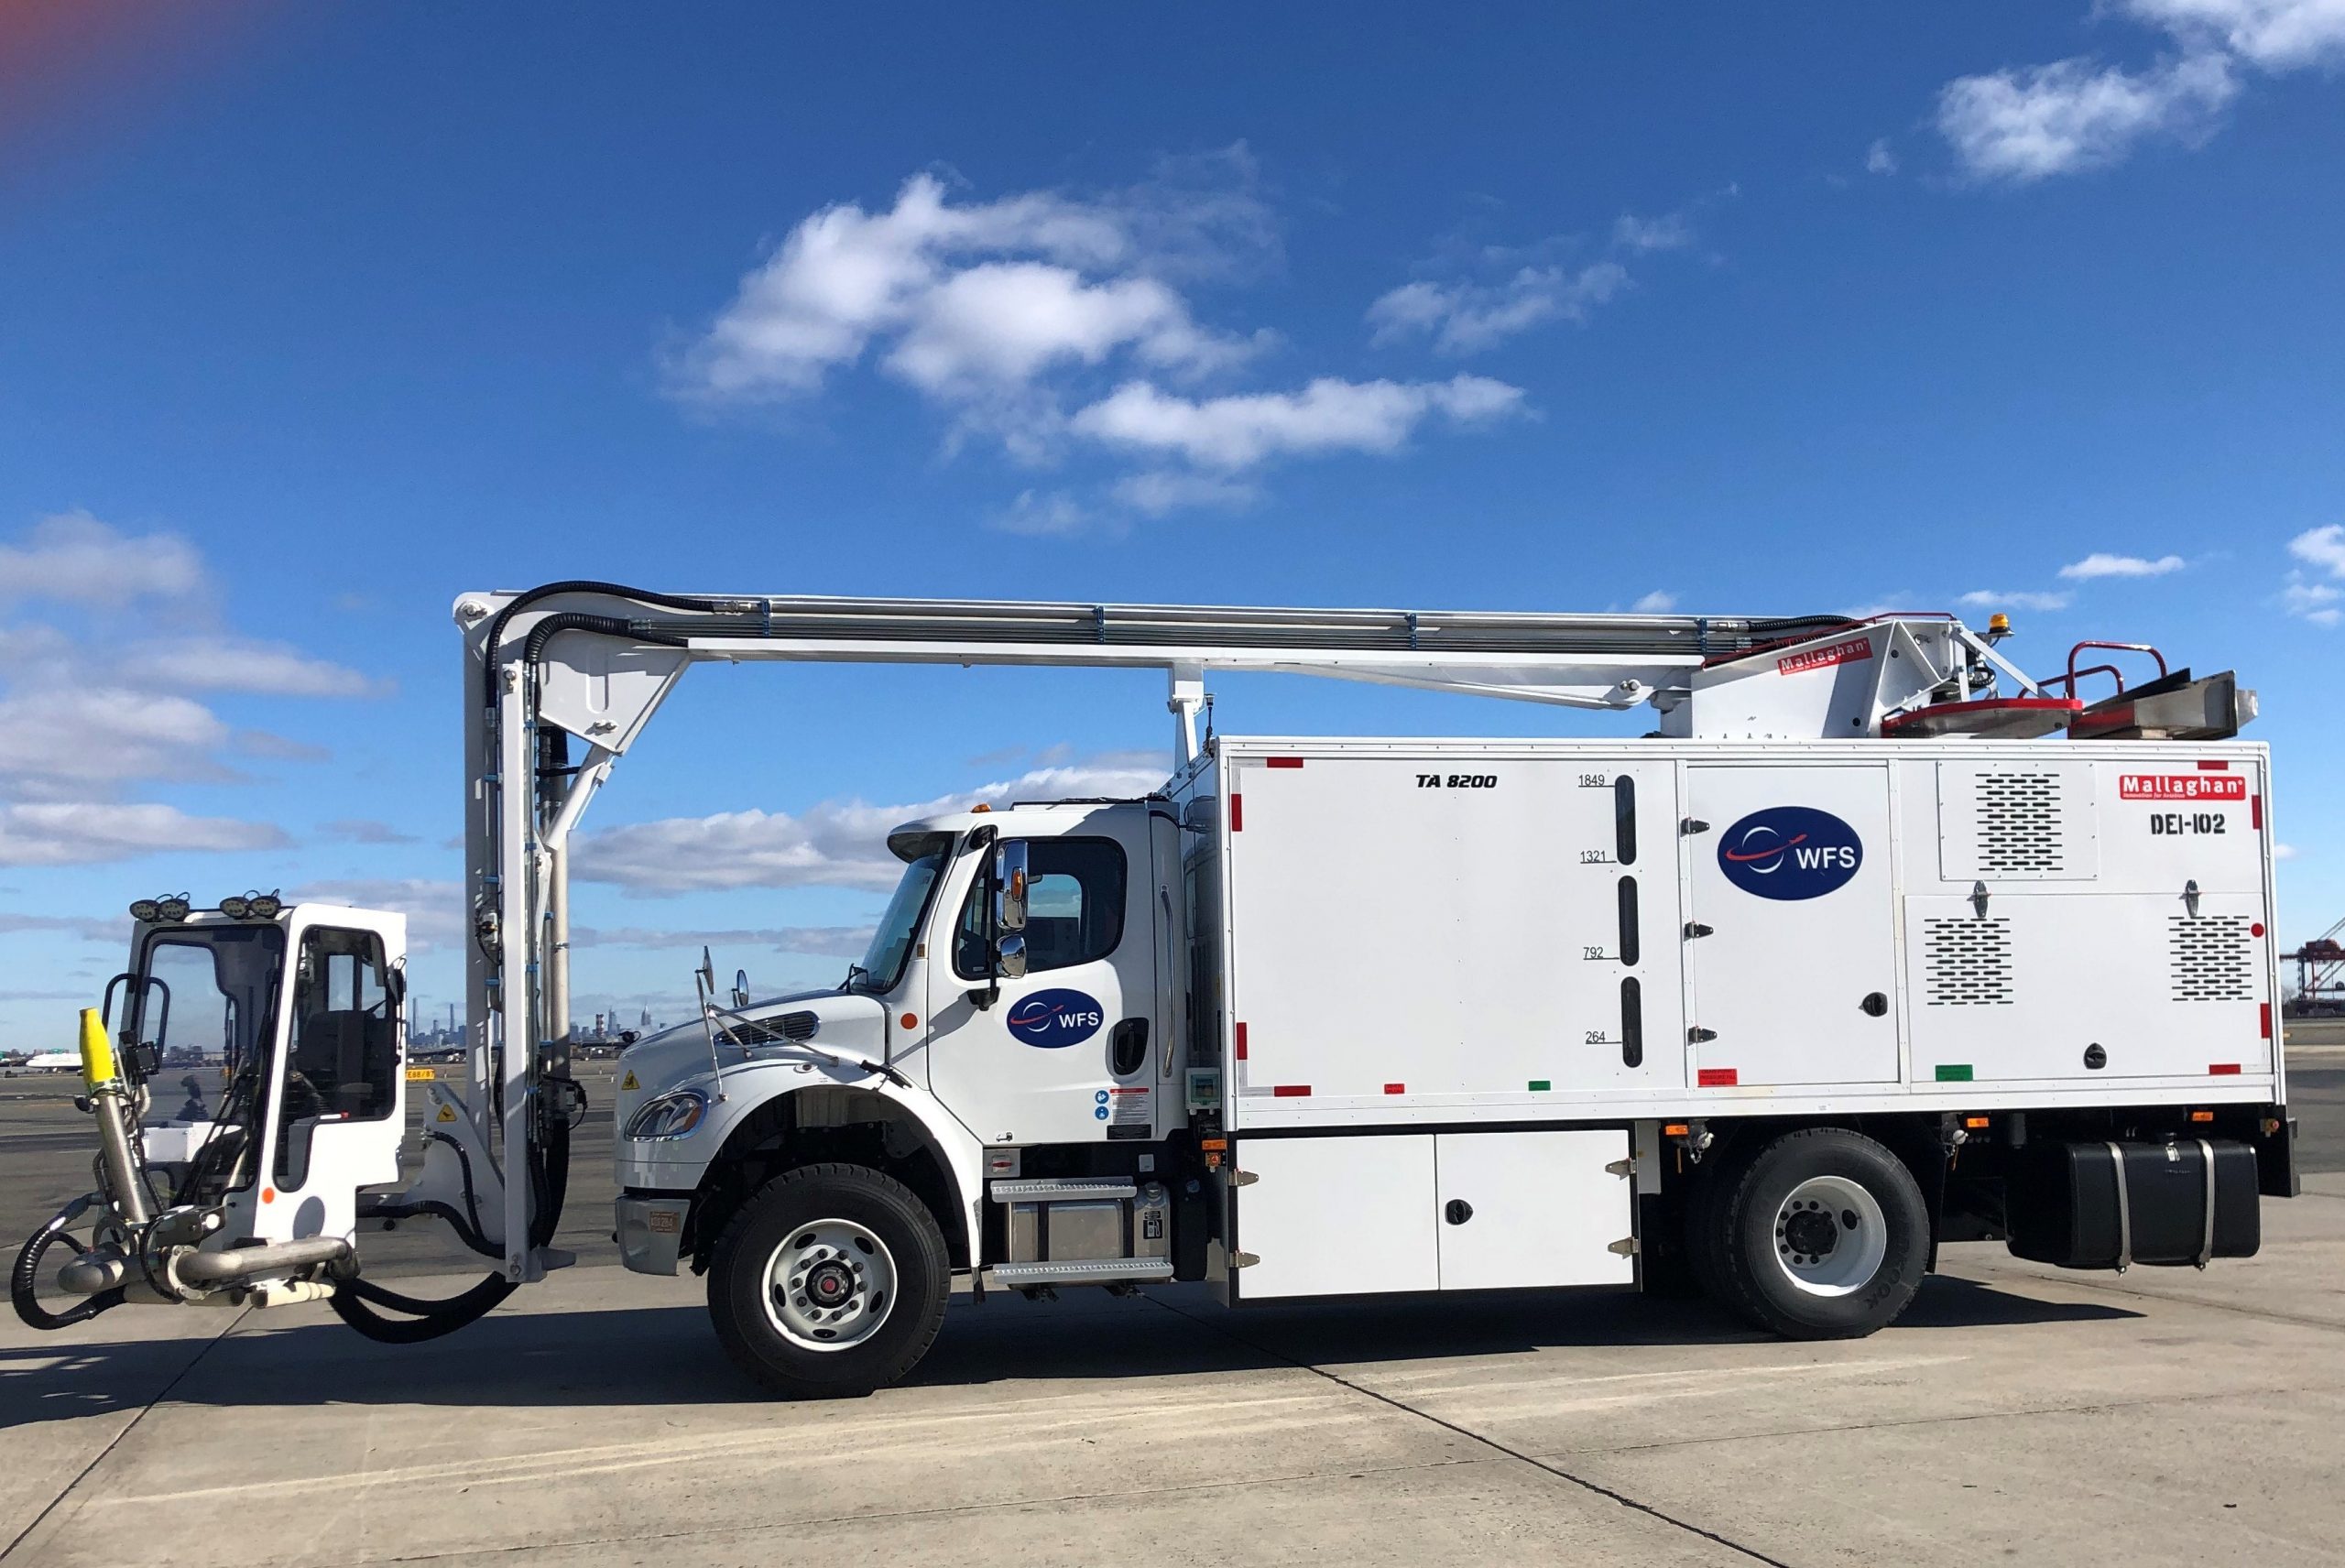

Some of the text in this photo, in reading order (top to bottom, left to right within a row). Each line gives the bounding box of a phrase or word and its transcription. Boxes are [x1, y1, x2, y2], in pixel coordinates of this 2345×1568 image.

[1781, 642, 1864, 670] Mallaghan
[1415, 774, 1498, 789] TA 8200
[1578, 774, 1605, 786] 1849
[2123, 777, 2238, 796] Mallaghan
[1580, 850, 1606, 862] 1321
[1795, 846, 1856, 869] WFS
[1583, 947, 1604, 958] 792
[1058, 1011, 1099, 1029] WFS
[1586, 1031, 1606, 1042] 264
